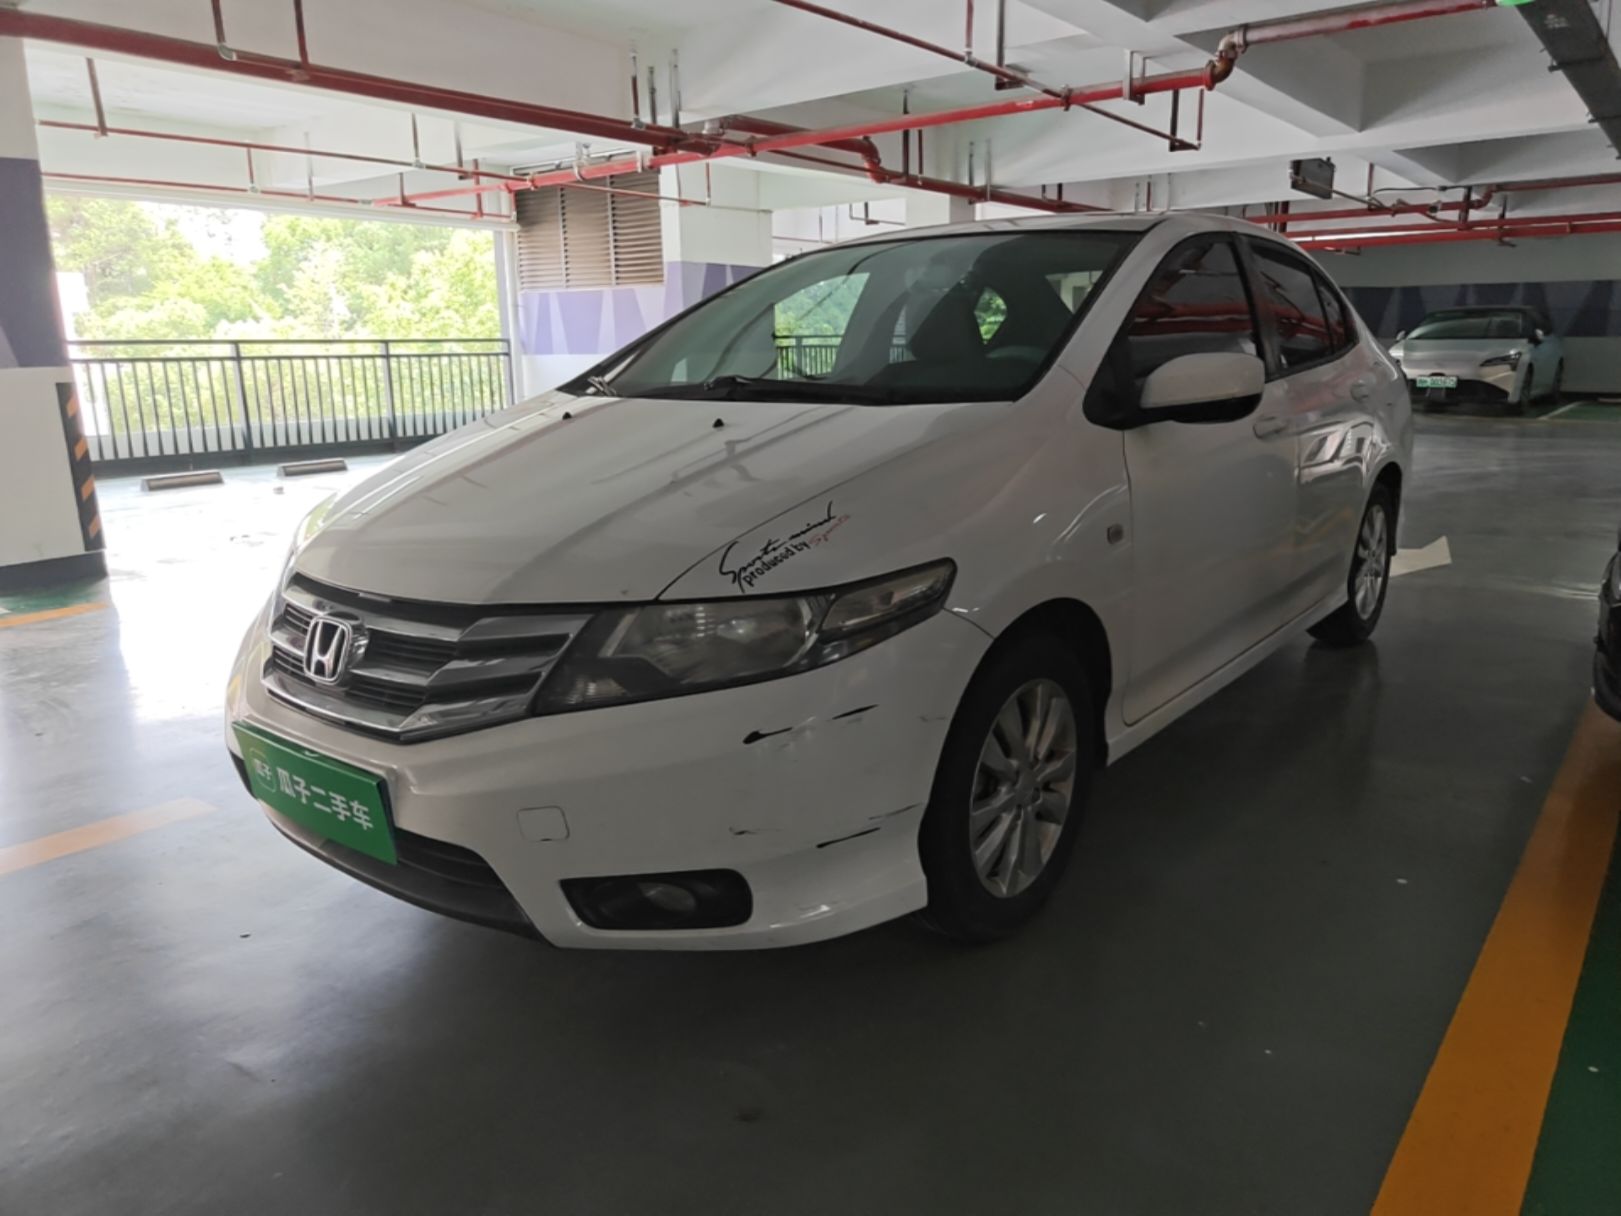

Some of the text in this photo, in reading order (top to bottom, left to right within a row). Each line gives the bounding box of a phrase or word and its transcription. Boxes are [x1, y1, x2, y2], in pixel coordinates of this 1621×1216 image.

[742, 540, 812, 588] produced by
[275, 765, 374, 831] 瓜子二手车
